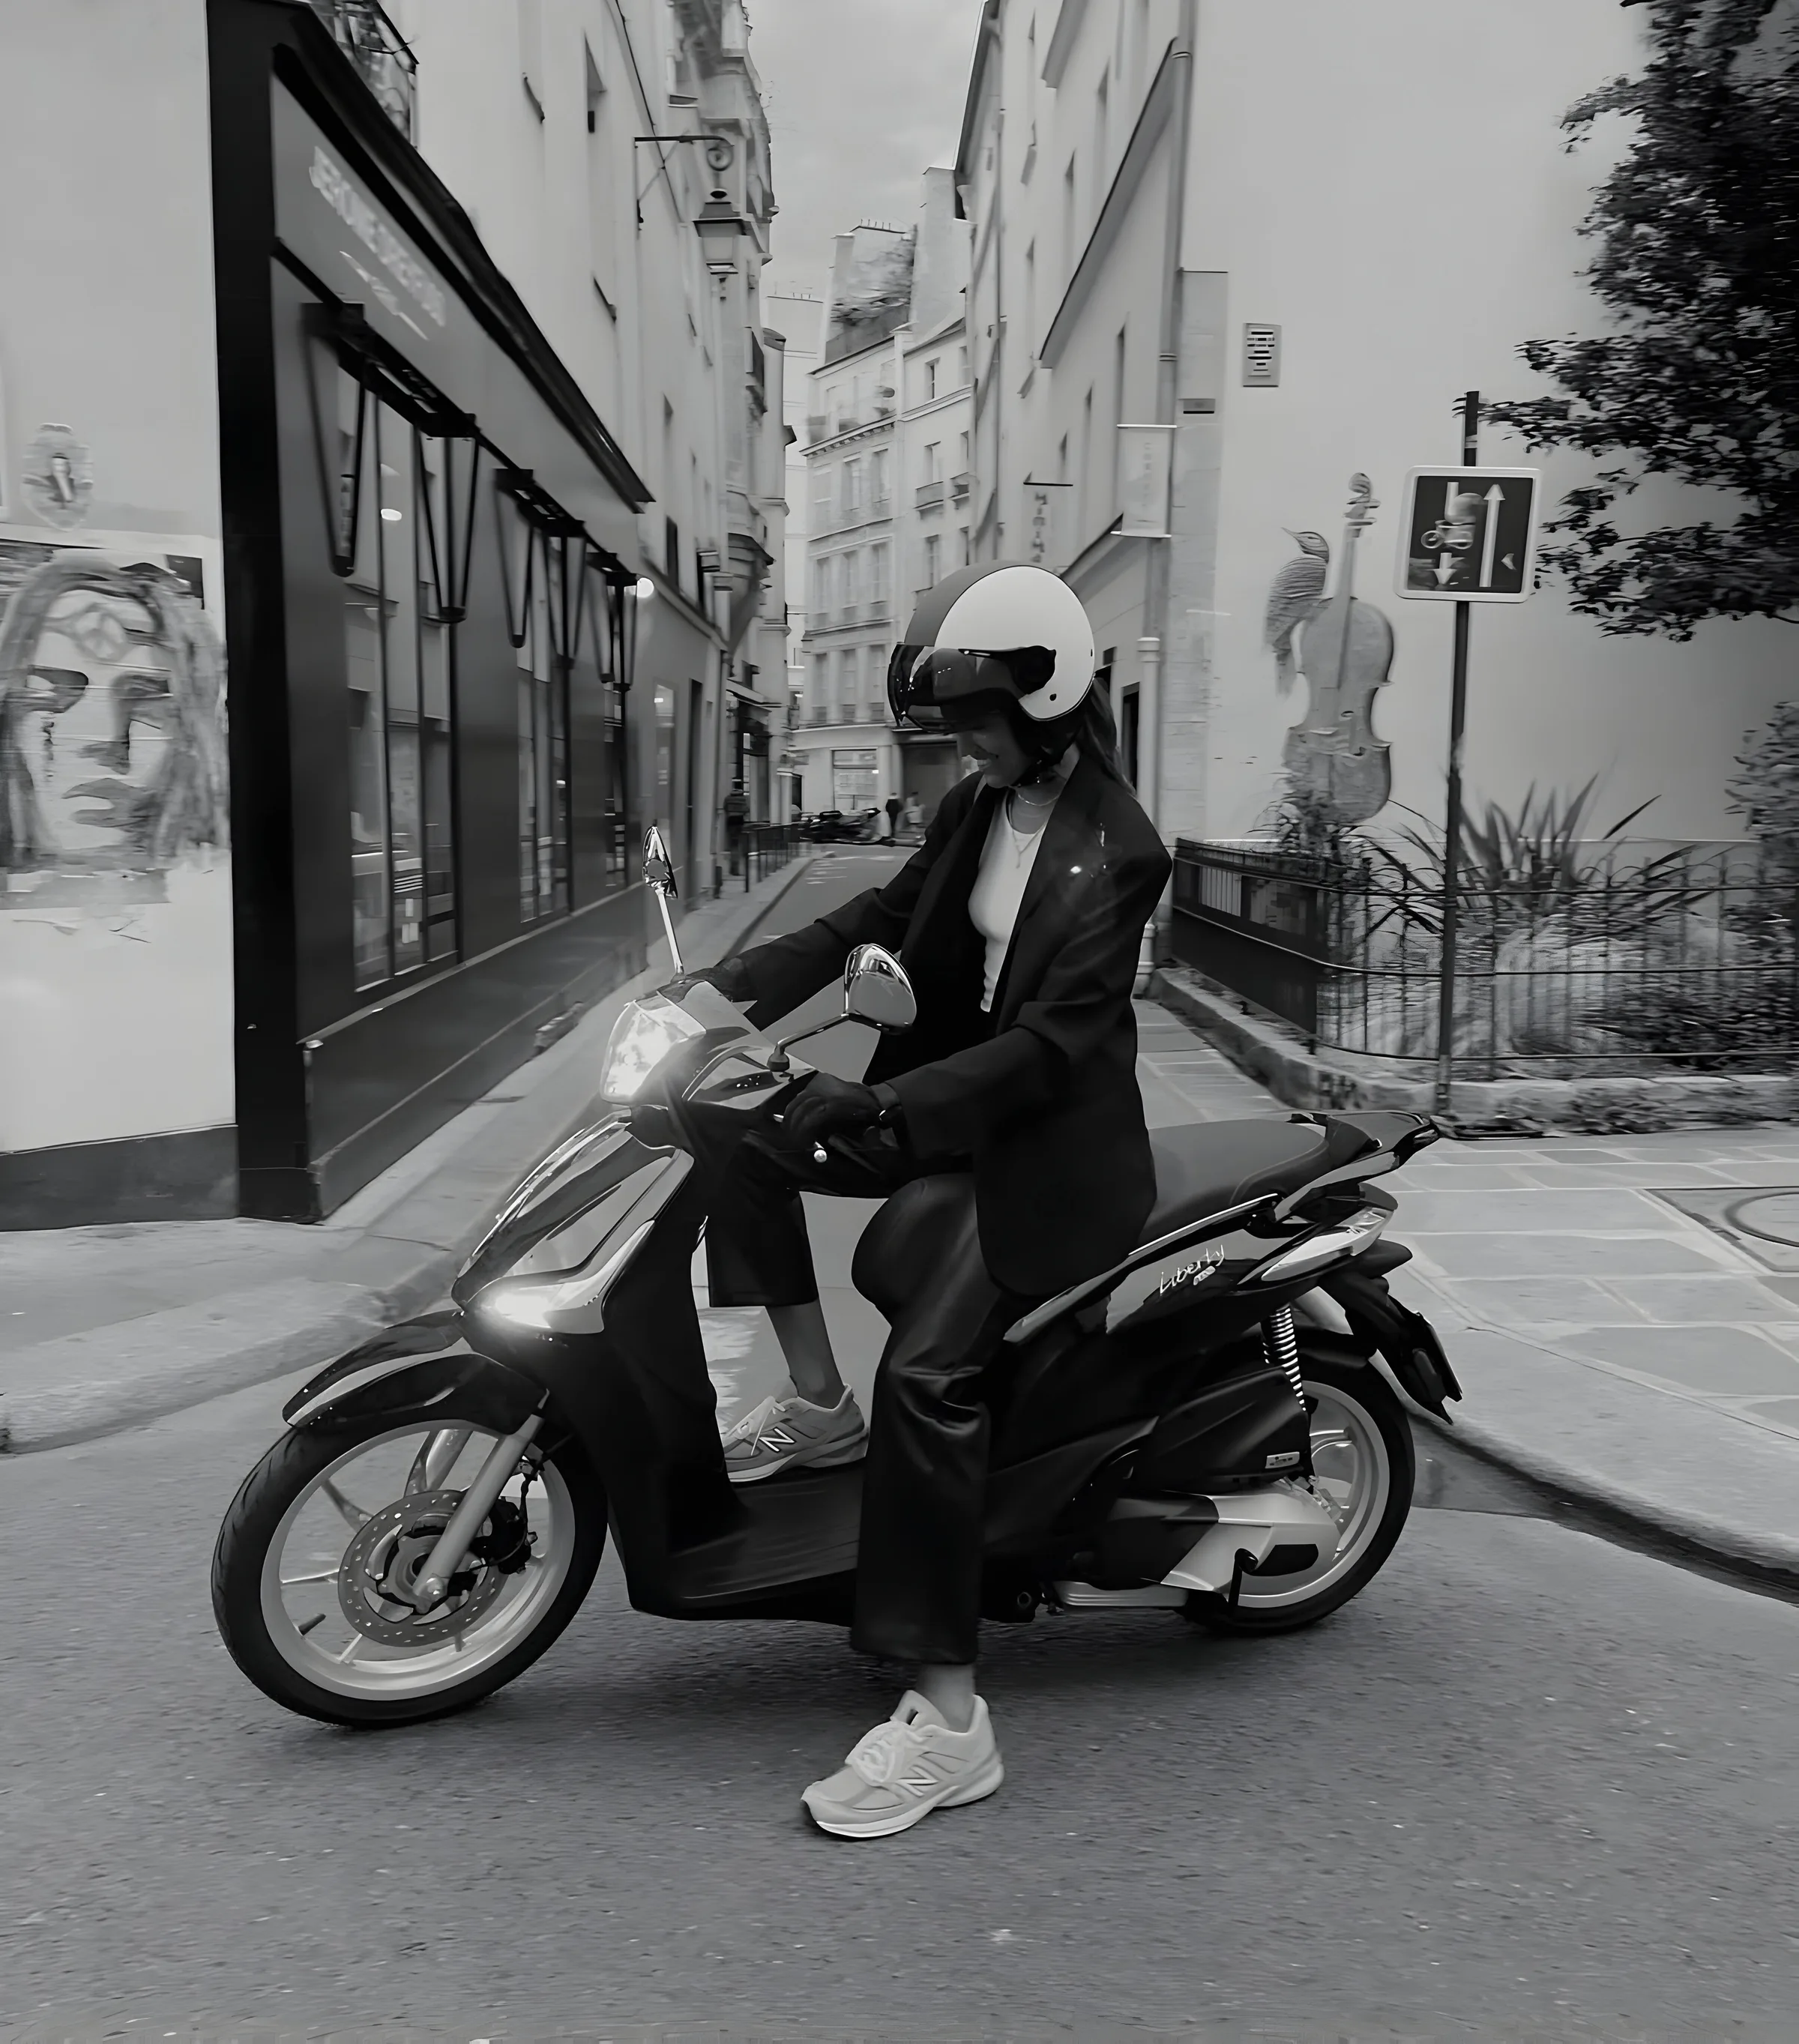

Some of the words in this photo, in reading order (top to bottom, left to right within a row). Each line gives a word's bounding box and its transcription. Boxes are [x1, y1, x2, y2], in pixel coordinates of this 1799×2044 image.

[1160, 1244, 1225, 1295] Liberty
[759, 1427, 795, 1453] N
[897, 1765, 938, 1796] N
